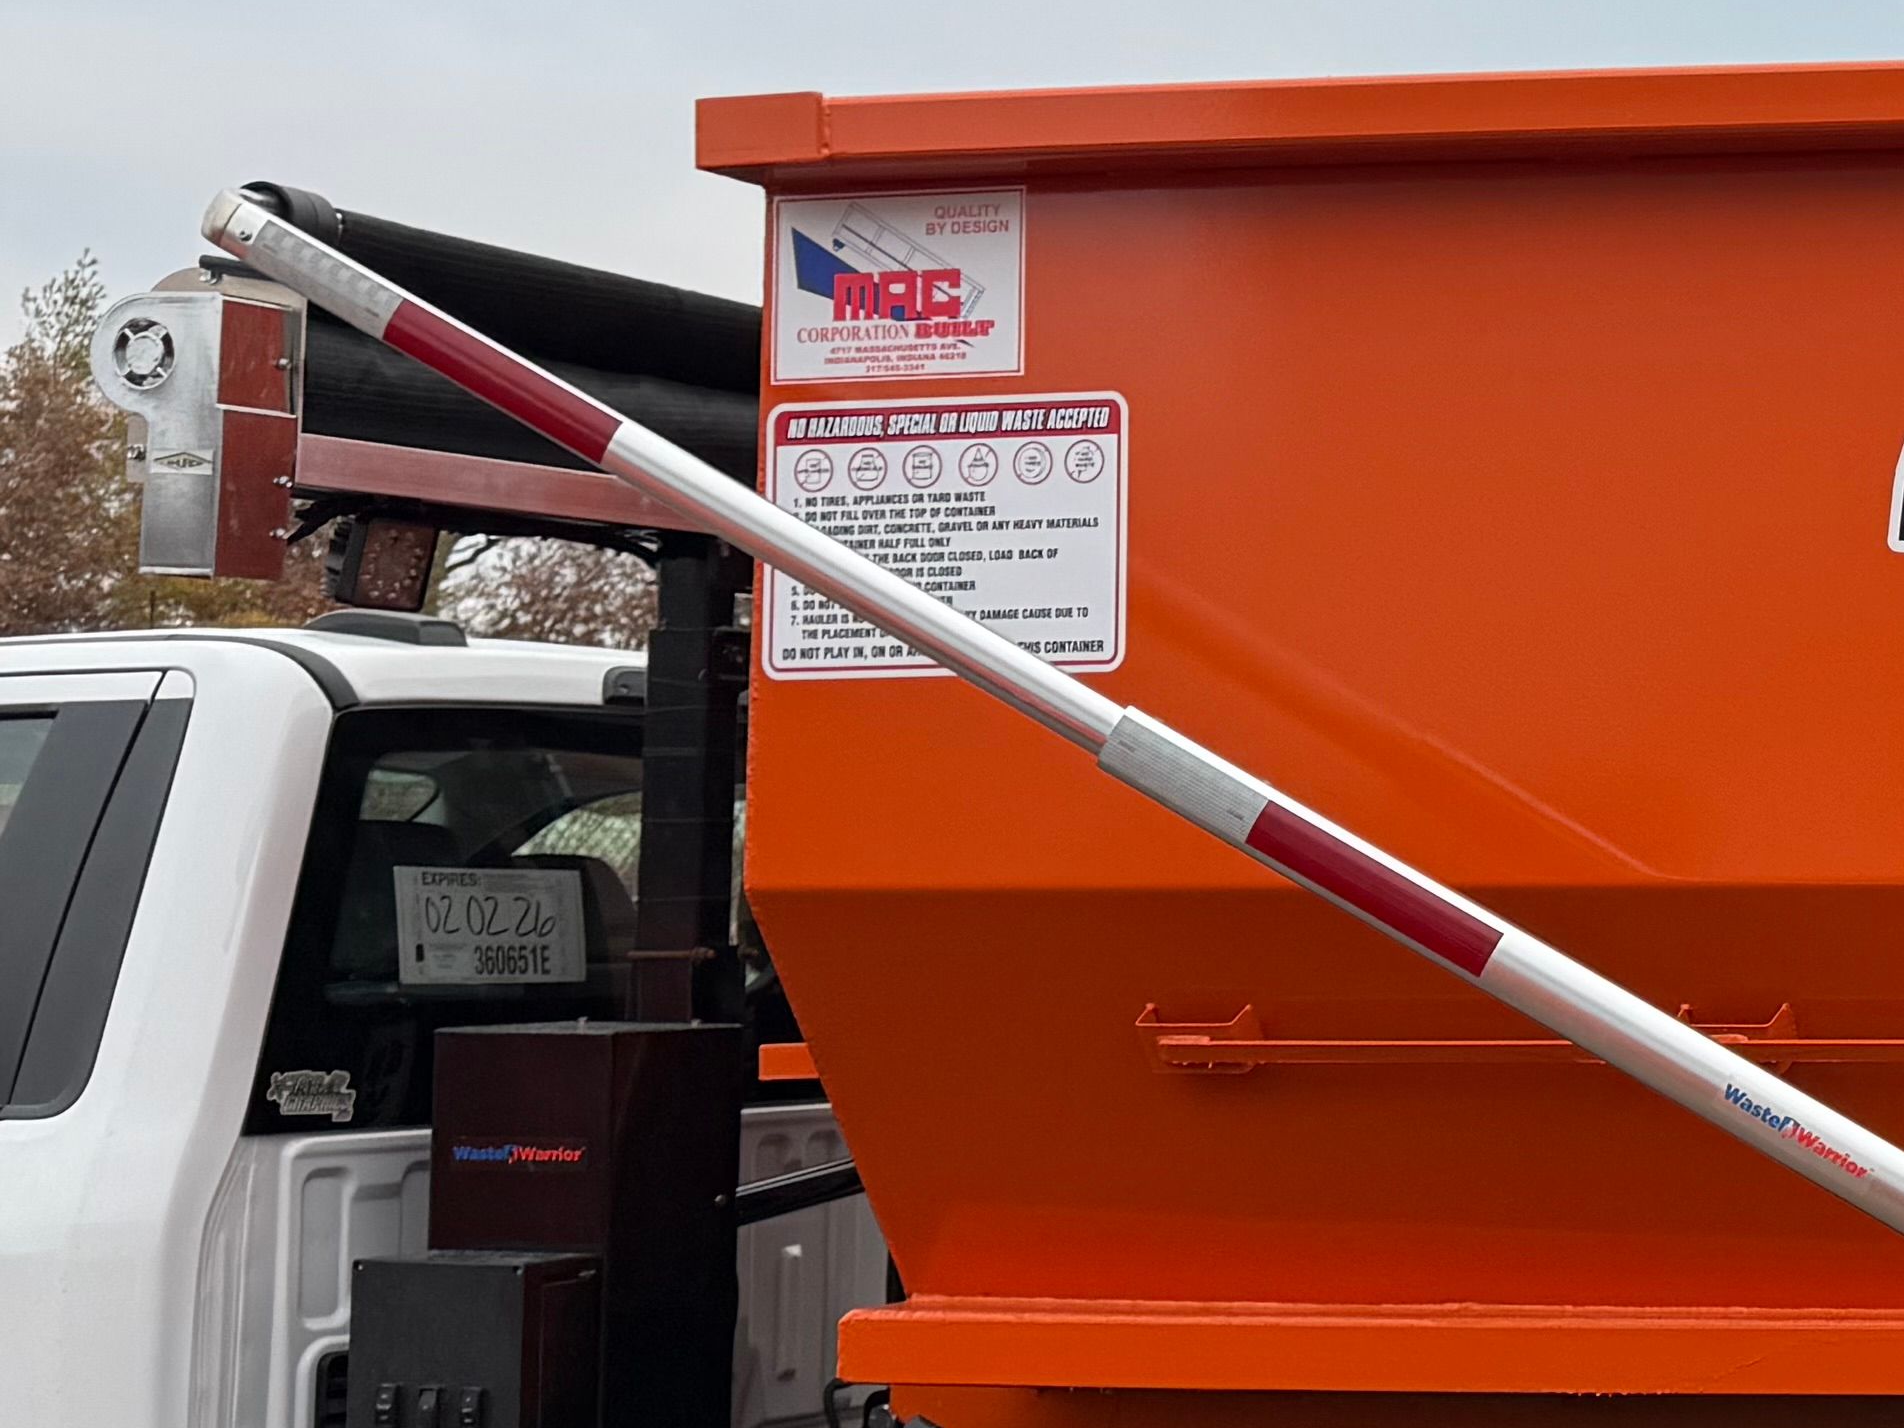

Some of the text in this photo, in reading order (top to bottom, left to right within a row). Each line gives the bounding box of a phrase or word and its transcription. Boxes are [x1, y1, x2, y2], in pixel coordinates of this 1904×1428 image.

[934, 204, 1000, 219] QUALITY
[925, 219, 1010, 235] BY DESIGN
[833, 269, 961, 321] MAC
[797, 319, 995, 344] CORPORATION BUILT
[787, 407, 1111, 440] NO HAZARDOUS, SPECIAL OR LIQUID WASTE ACCEPTED
[821, 496, 849, 508] TIRES,
[852, 494, 909, 506] APPLIANCES
[927, 492, 951, 503] YARD
[954, 491, 985, 503] WASTE
[820, 511, 838, 521] NOT
[840, 510, 859, 520] FILL
[862, 509, 886, 520] OVER
[889, 508, 906, 519] THE
[909, 508, 927, 518] TOP
[930, 507, 941, 518] OF
[944, 506, 996, 517] CONTAINER
[938, 520, 973, 532] GRAVEL
[992, 519, 1010, 530] ANY
[1013, 518, 1043, 530] HEAVY
[1046, 517, 1099, 529] MATERIALS
[929, 537, 951, 547] ONLY
[893, 553, 916, 563] BACK
[1019, 549, 1043, 559] BACK
[1047, 548, 1058, 559] OF
[927, 566, 962, 577] CLOSED
[1055, 607, 1073, 618] DUE
[1077, 607, 1088, 618] TO
[821, 628, 876, 639] PLACEMENT
[782, 648, 797, 660] DO
[800, 647, 820, 660] NOT
[824, 646, 850, 659] PLAY
[871, 646, 886, 658] ON
[889, 645, 903, 657] OR
[1044, 640, 1104, 653] CONTAINER
[421, 872, 481, 886] EXPIRES:
[425, 895, 460, 934] 02
[467, 895, 509, 937] 02
[474, 945, 552, 975] 360651E
[1724, 1083, 1868, 1179] Waste Warrior
